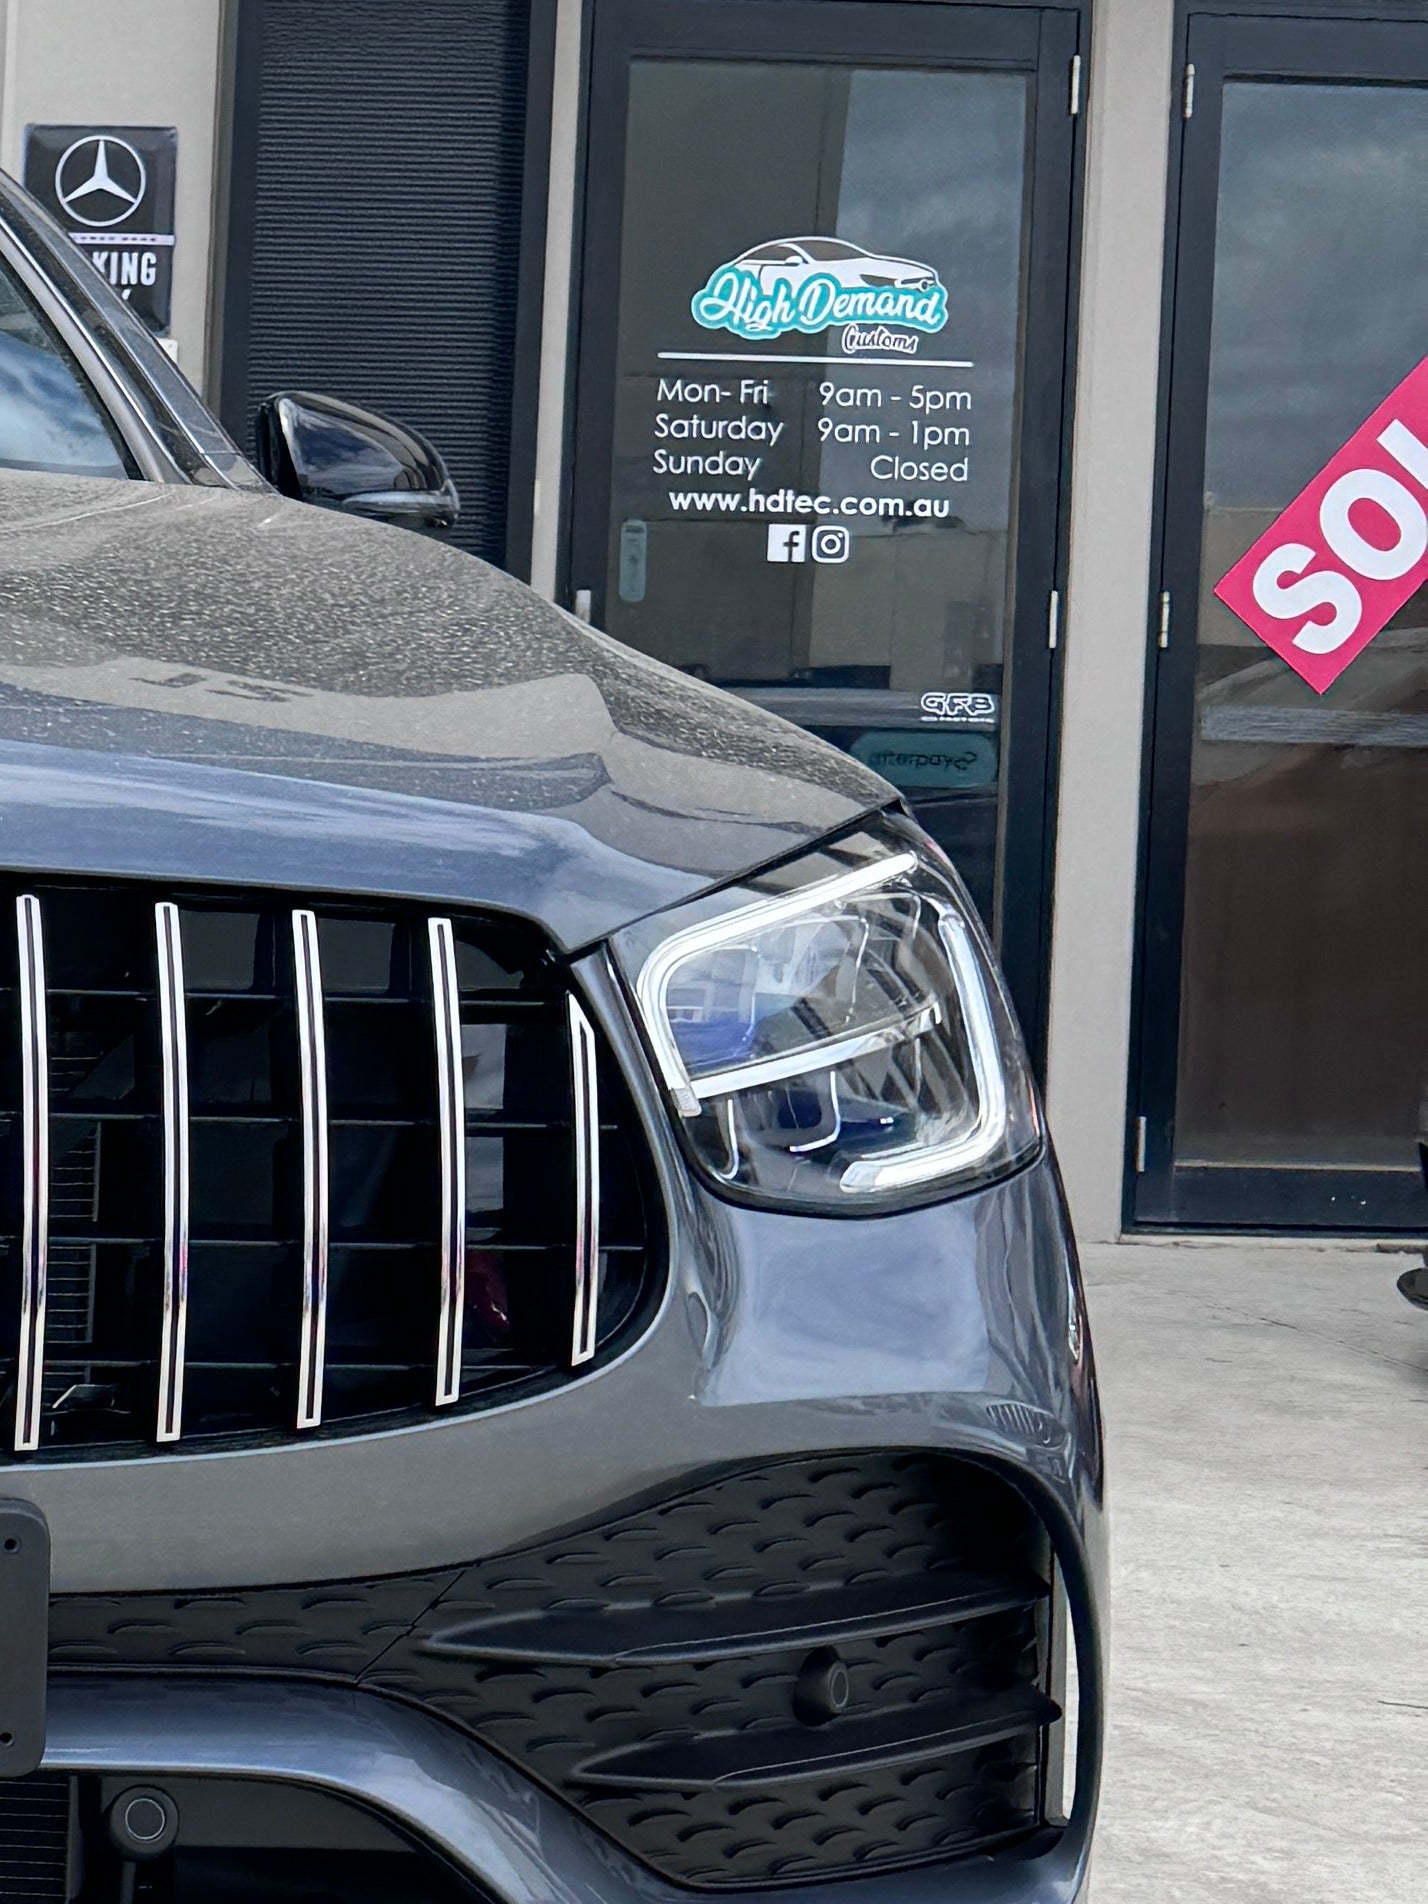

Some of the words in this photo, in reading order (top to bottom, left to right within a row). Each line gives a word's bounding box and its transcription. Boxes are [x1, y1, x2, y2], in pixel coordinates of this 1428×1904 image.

[699, 271, 796, 332] High
[799, 278, 941, 325] Demand
[843, 324, 918, 353] Customs
[818, 382, 882, 408] 9am
[909, 385, 973, 415] 5pm
[654, 413, 784, 446] Saturday
[817, 418, 881, 444] 9am
[911, 421, 970, 450] 1pm
[653, 449, 761, 481] Sunday
[870, 456, 969, 483] Closed
[669, 488, 950, 518] www.hdtec.com.au
